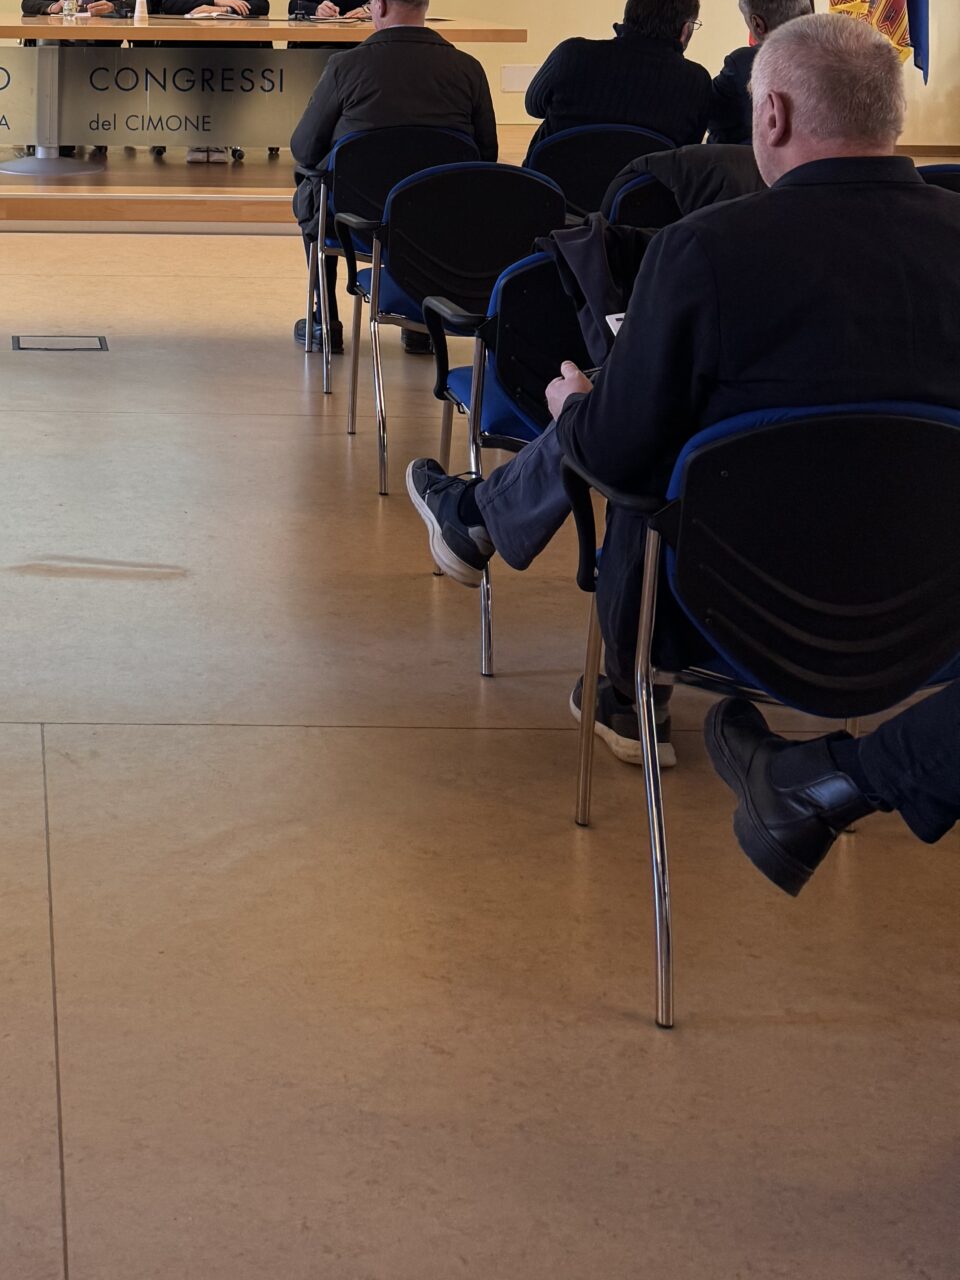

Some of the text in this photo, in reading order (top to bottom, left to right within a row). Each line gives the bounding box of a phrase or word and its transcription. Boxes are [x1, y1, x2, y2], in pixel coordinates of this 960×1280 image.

[89, 67, 284, 93] CONGRESSI
[89, 113, 118, 131] del
[126, 114, 211, 132] CIMONE
